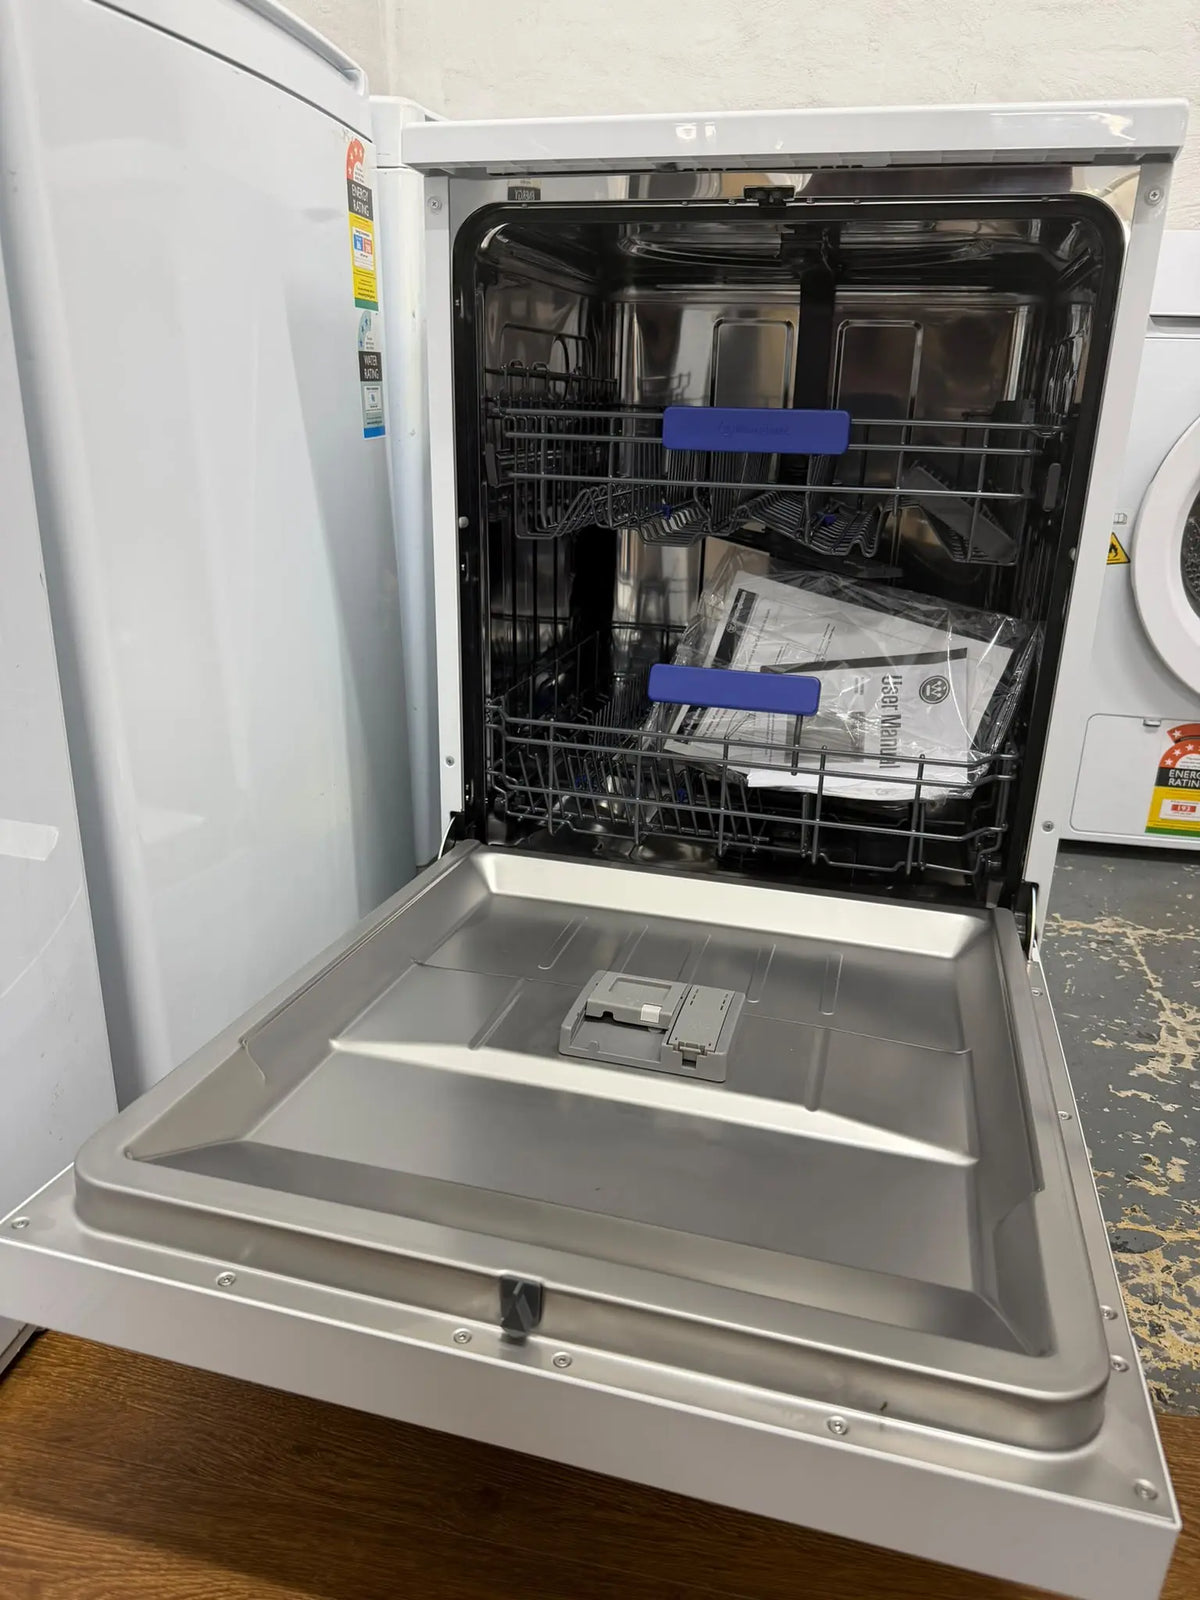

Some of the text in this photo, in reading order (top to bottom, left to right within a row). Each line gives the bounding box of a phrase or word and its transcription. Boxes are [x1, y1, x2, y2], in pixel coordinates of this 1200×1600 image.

[351, 183, 369, 201] ENERGY
[352, 201, 370, 217] RATING
[363, 354, 378, 367] WATER
[363, 367, 379, 380] RATING
[880, 675, 903, 711] User
